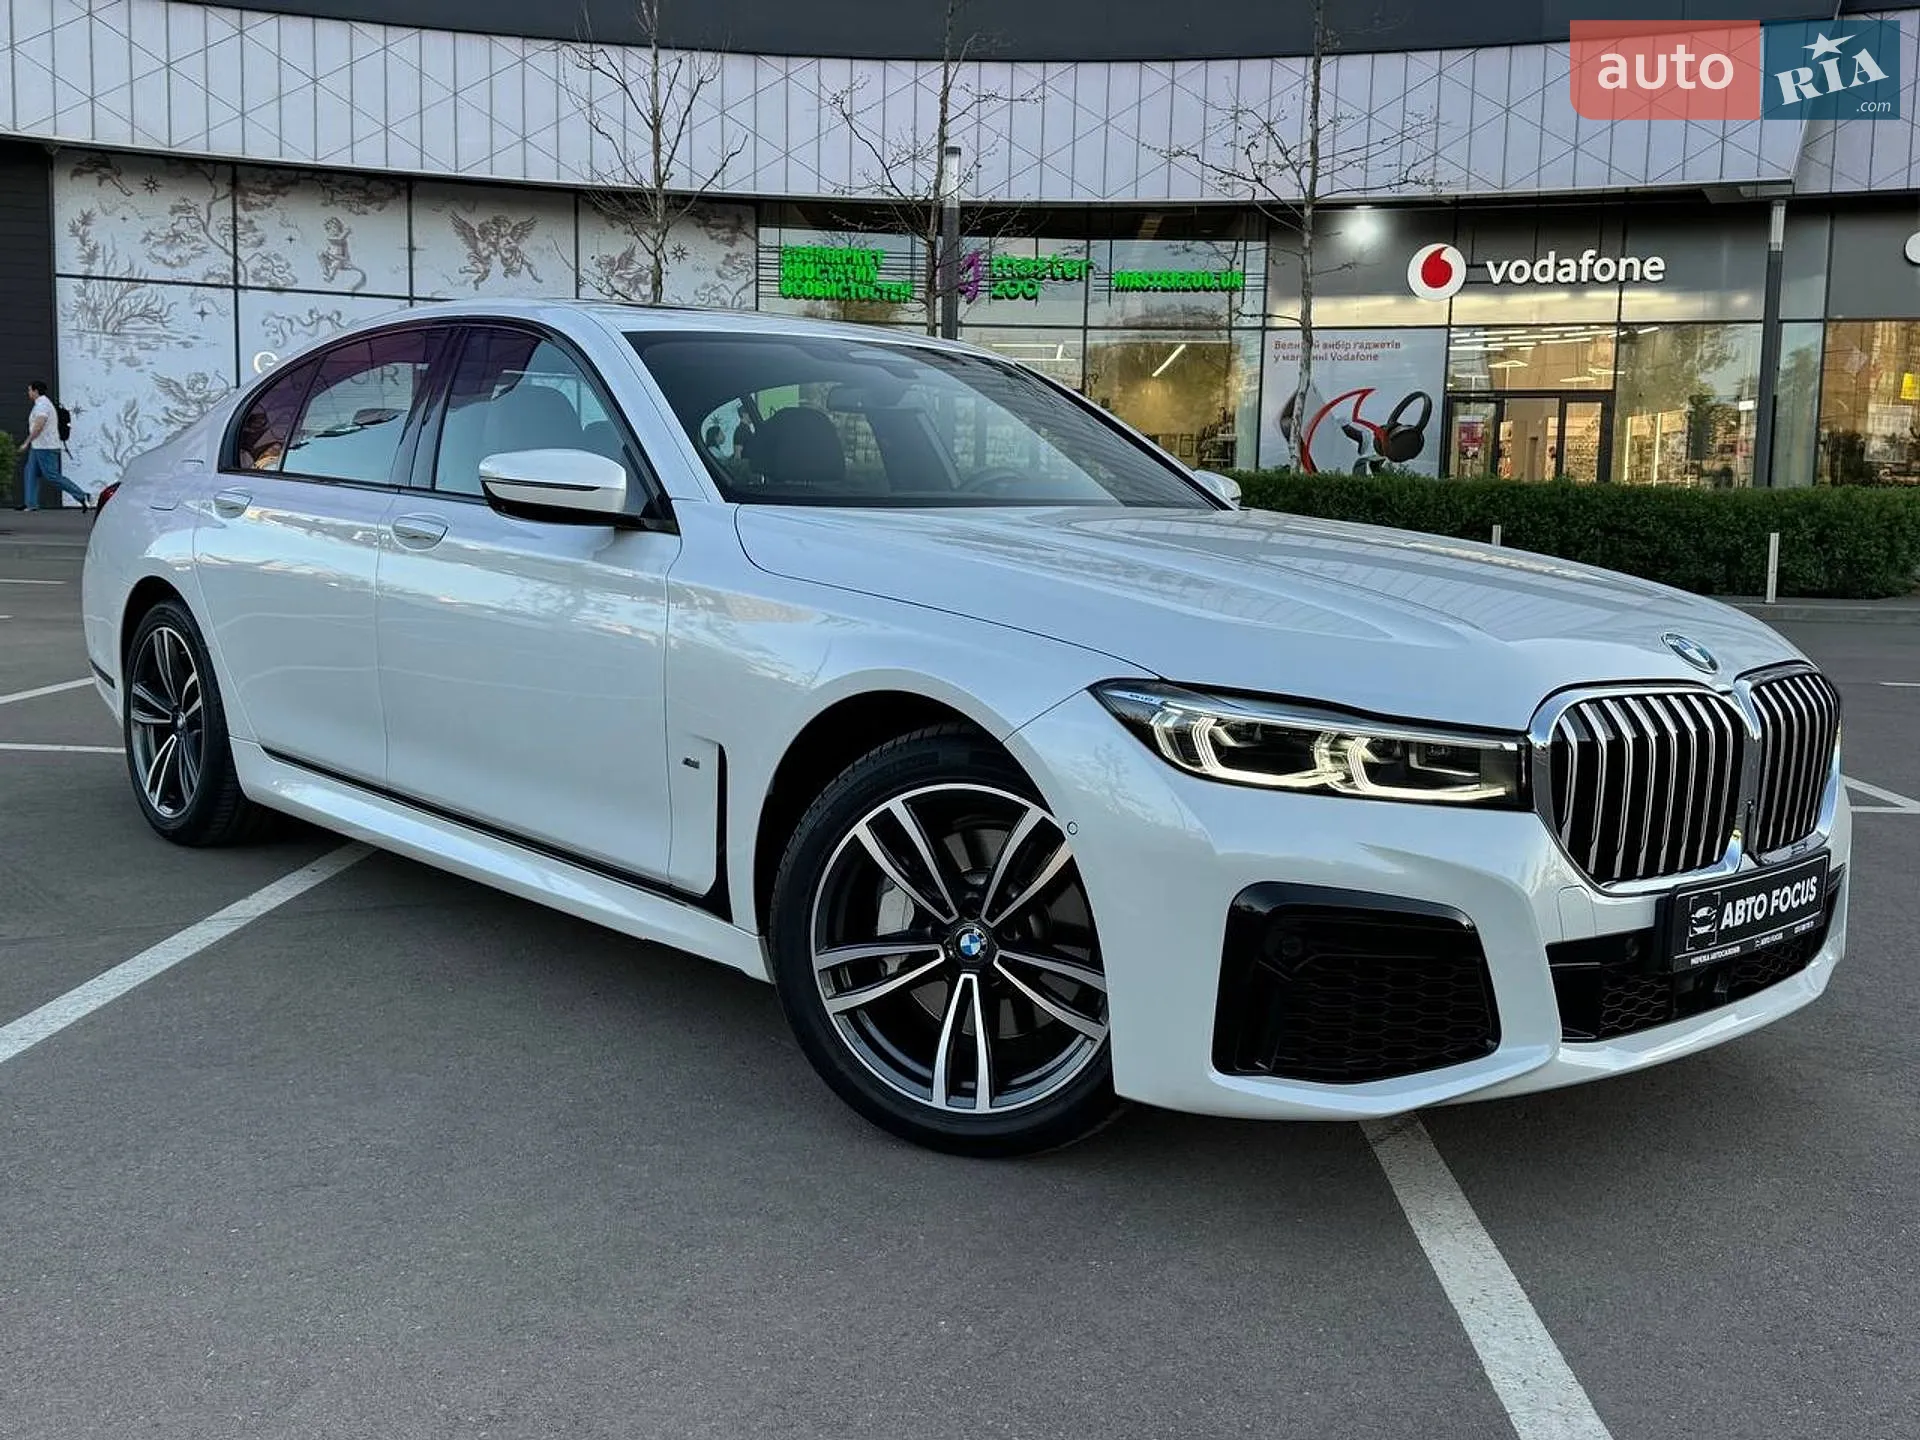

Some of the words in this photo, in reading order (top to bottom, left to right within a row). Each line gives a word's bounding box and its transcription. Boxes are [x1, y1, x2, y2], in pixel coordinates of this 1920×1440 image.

[1486, 250, 1666, 284] vodafone
[1330, 351, 1380, 361] Vodafone
[1720, 893, 1767, 930] АВТО
[1769, 876, 1817, 916] FOCUS
